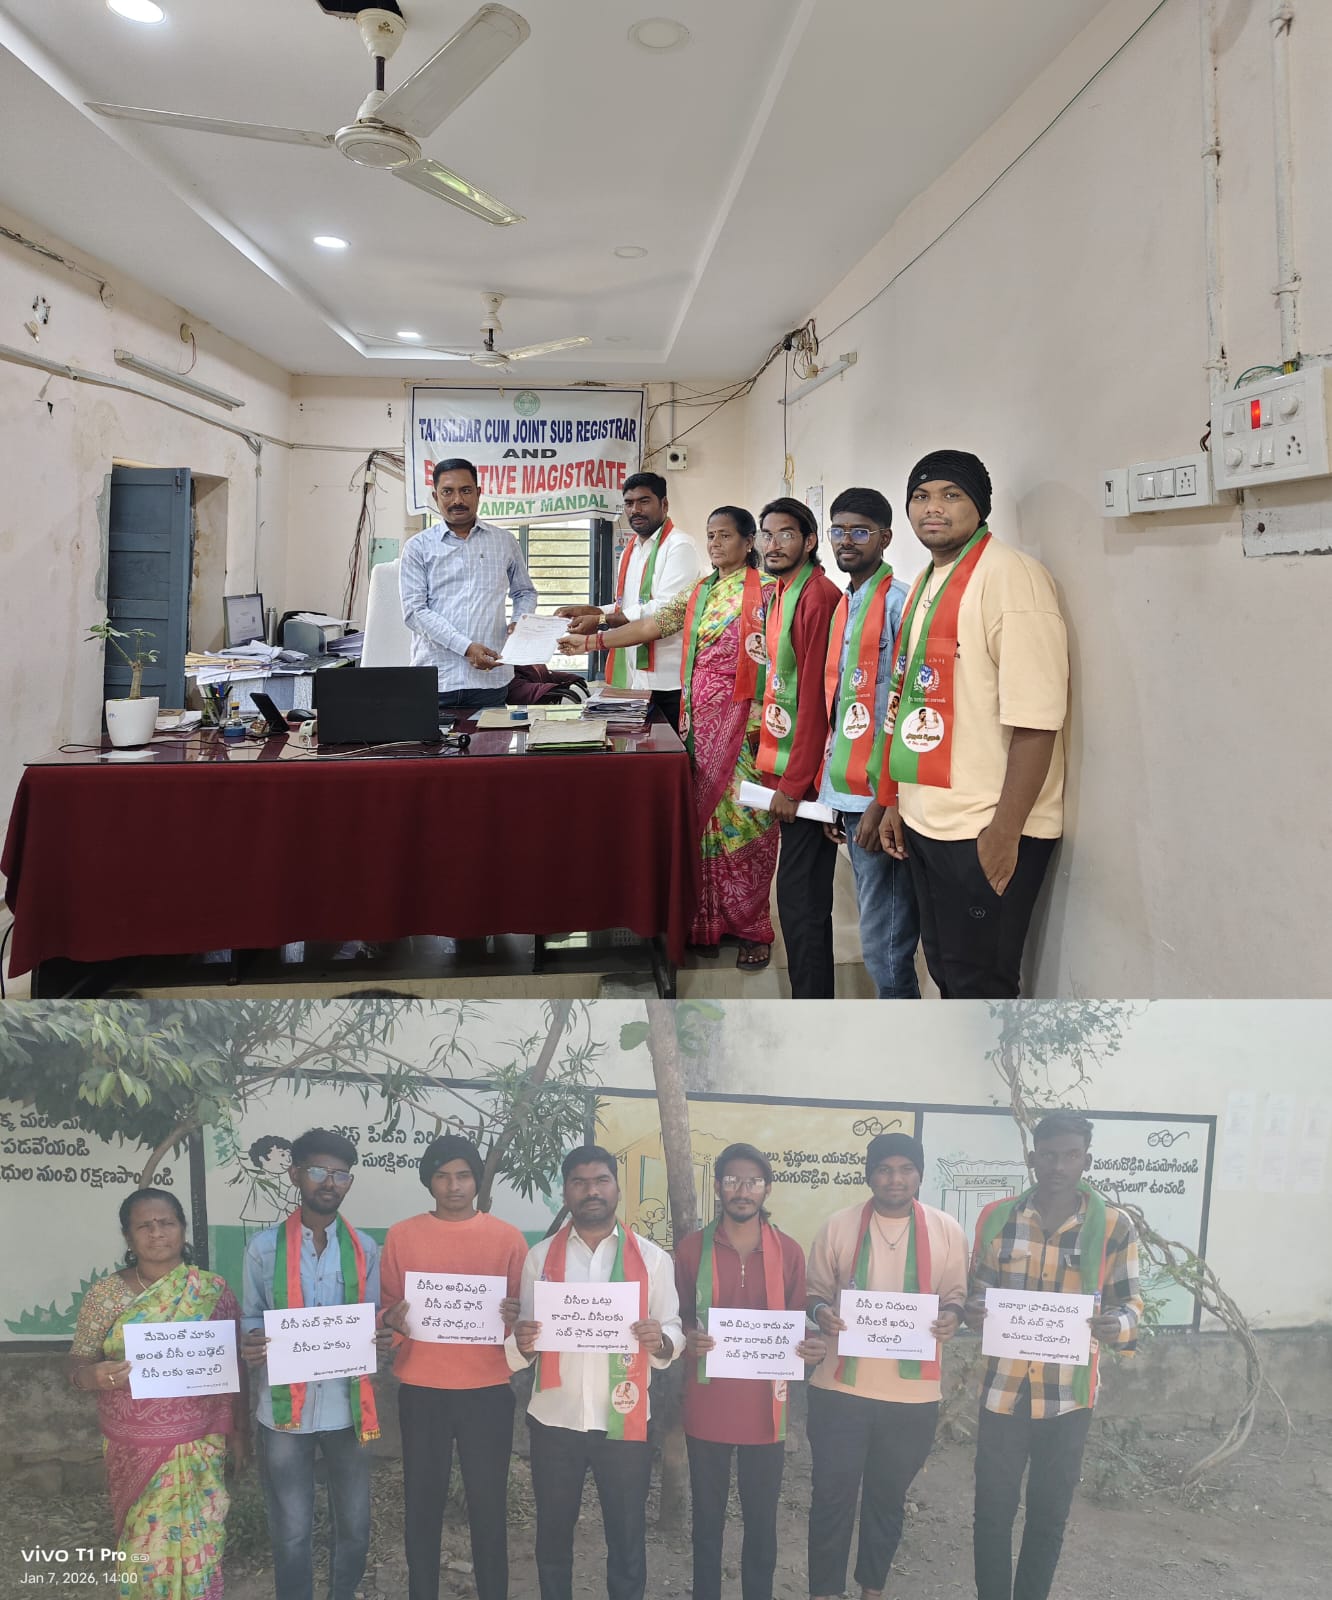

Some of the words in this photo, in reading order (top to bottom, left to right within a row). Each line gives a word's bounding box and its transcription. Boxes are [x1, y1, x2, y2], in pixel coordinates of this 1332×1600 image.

[419, 418, 481, 443] TAHSILDAR
[485, 419, 510, 443] CUM
[513, 419, 547, 443] JOINT
[550, 419, 573, 443] SUB
[576, 418, 637, 443] REGISTRAR
[502, 448, 557, 458] AND
[424, 460, 516, 495] ETIVE
[522, 459, 627, 494] MAGISTRATE
[478, 501, 535, 516] AMPAT
[541, 494, 608, 512] MANDAL
[0, 1164, 33, 1184] ధుల
[37, 1165, 77, 1183] నుంచి
[444, 1300, 462, 1310] సబ్
[302, 1316, 320, 1328] సబ్
[346, 1315, 360, 1325] మా
[136, 1350, 163, 1360] అంత
